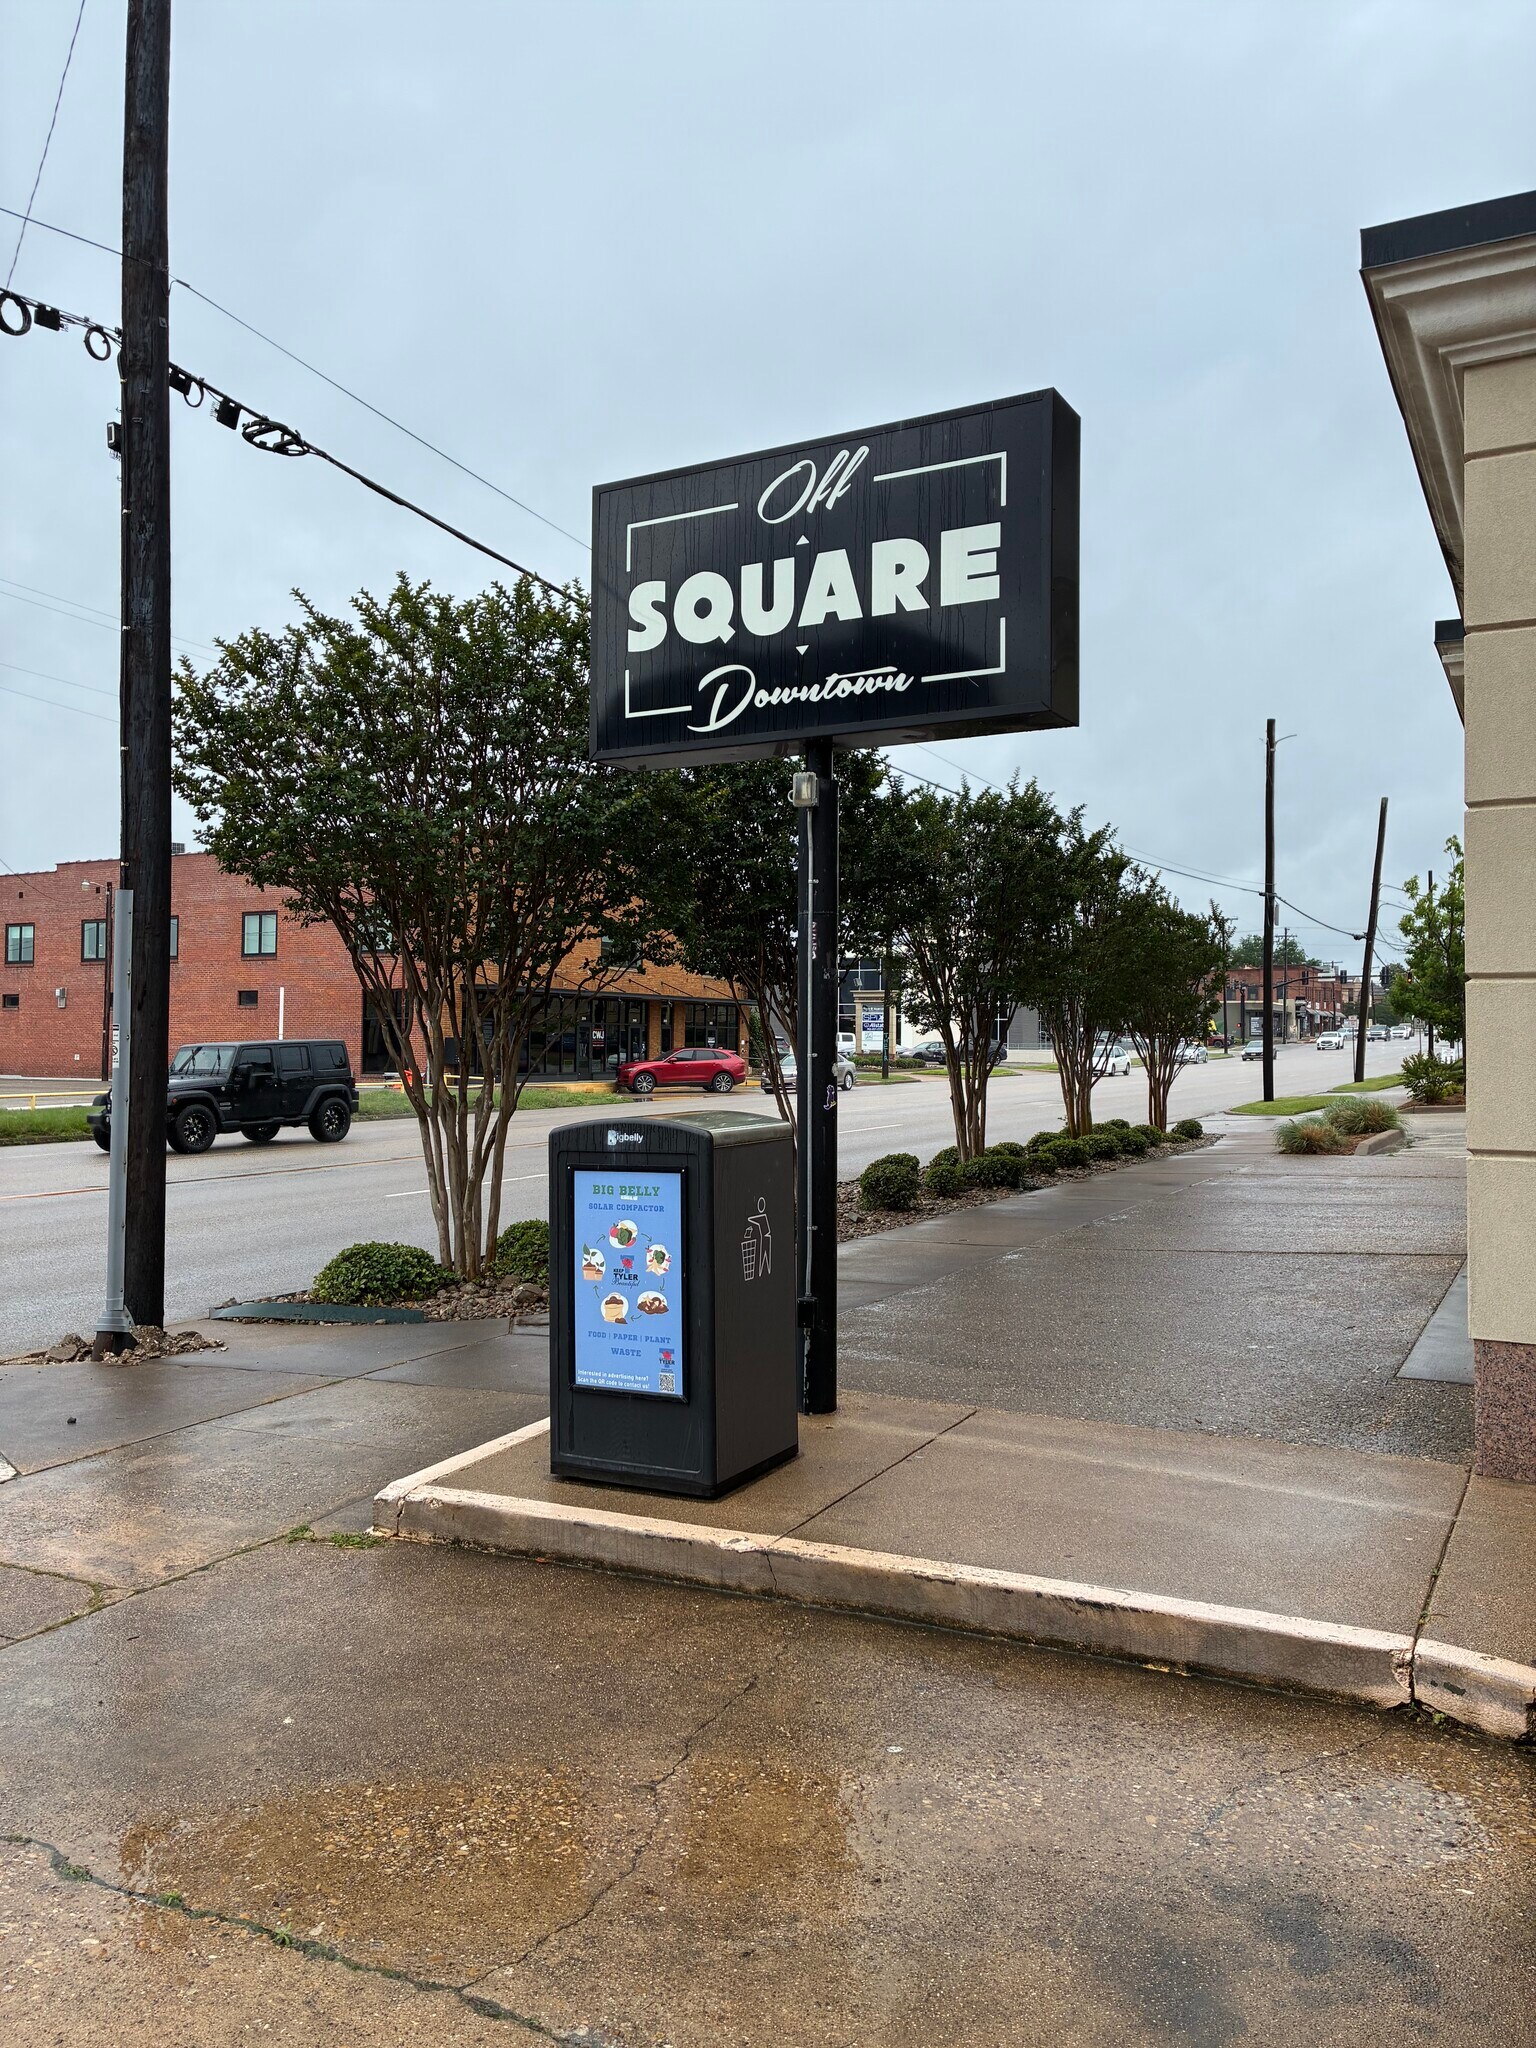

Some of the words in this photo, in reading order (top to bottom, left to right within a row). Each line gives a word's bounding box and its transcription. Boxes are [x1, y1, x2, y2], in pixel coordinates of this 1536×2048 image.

[757, 445, 869, 524] Off
[627, 522, 1001, 653] SQUARE
[687, 664, 914, 733] Downtown
[592, 1030, 605, 1039] CWJ
[592, 1185, 614, 1195] BIG
[619, 1186, 660, 1196] BELLY
[588, 1203, 614, 1211] SOLAR
[616, 1204, 665, 1212] COMPACTOR
[614, 1273, 639, 1281] TYLER
[611, 1279, 640, 1289] Beautiful
[588, 1331, 607, 1339] FOOD
[613, 1333, 638, 1341] PAPER
[645, 1335, 671, 1344] PLANT
[611, 1347, 642, 1357] WASTE
[578, 1369, 601, 1377] Interested
[608, 1372, 634, 1381] advertising
